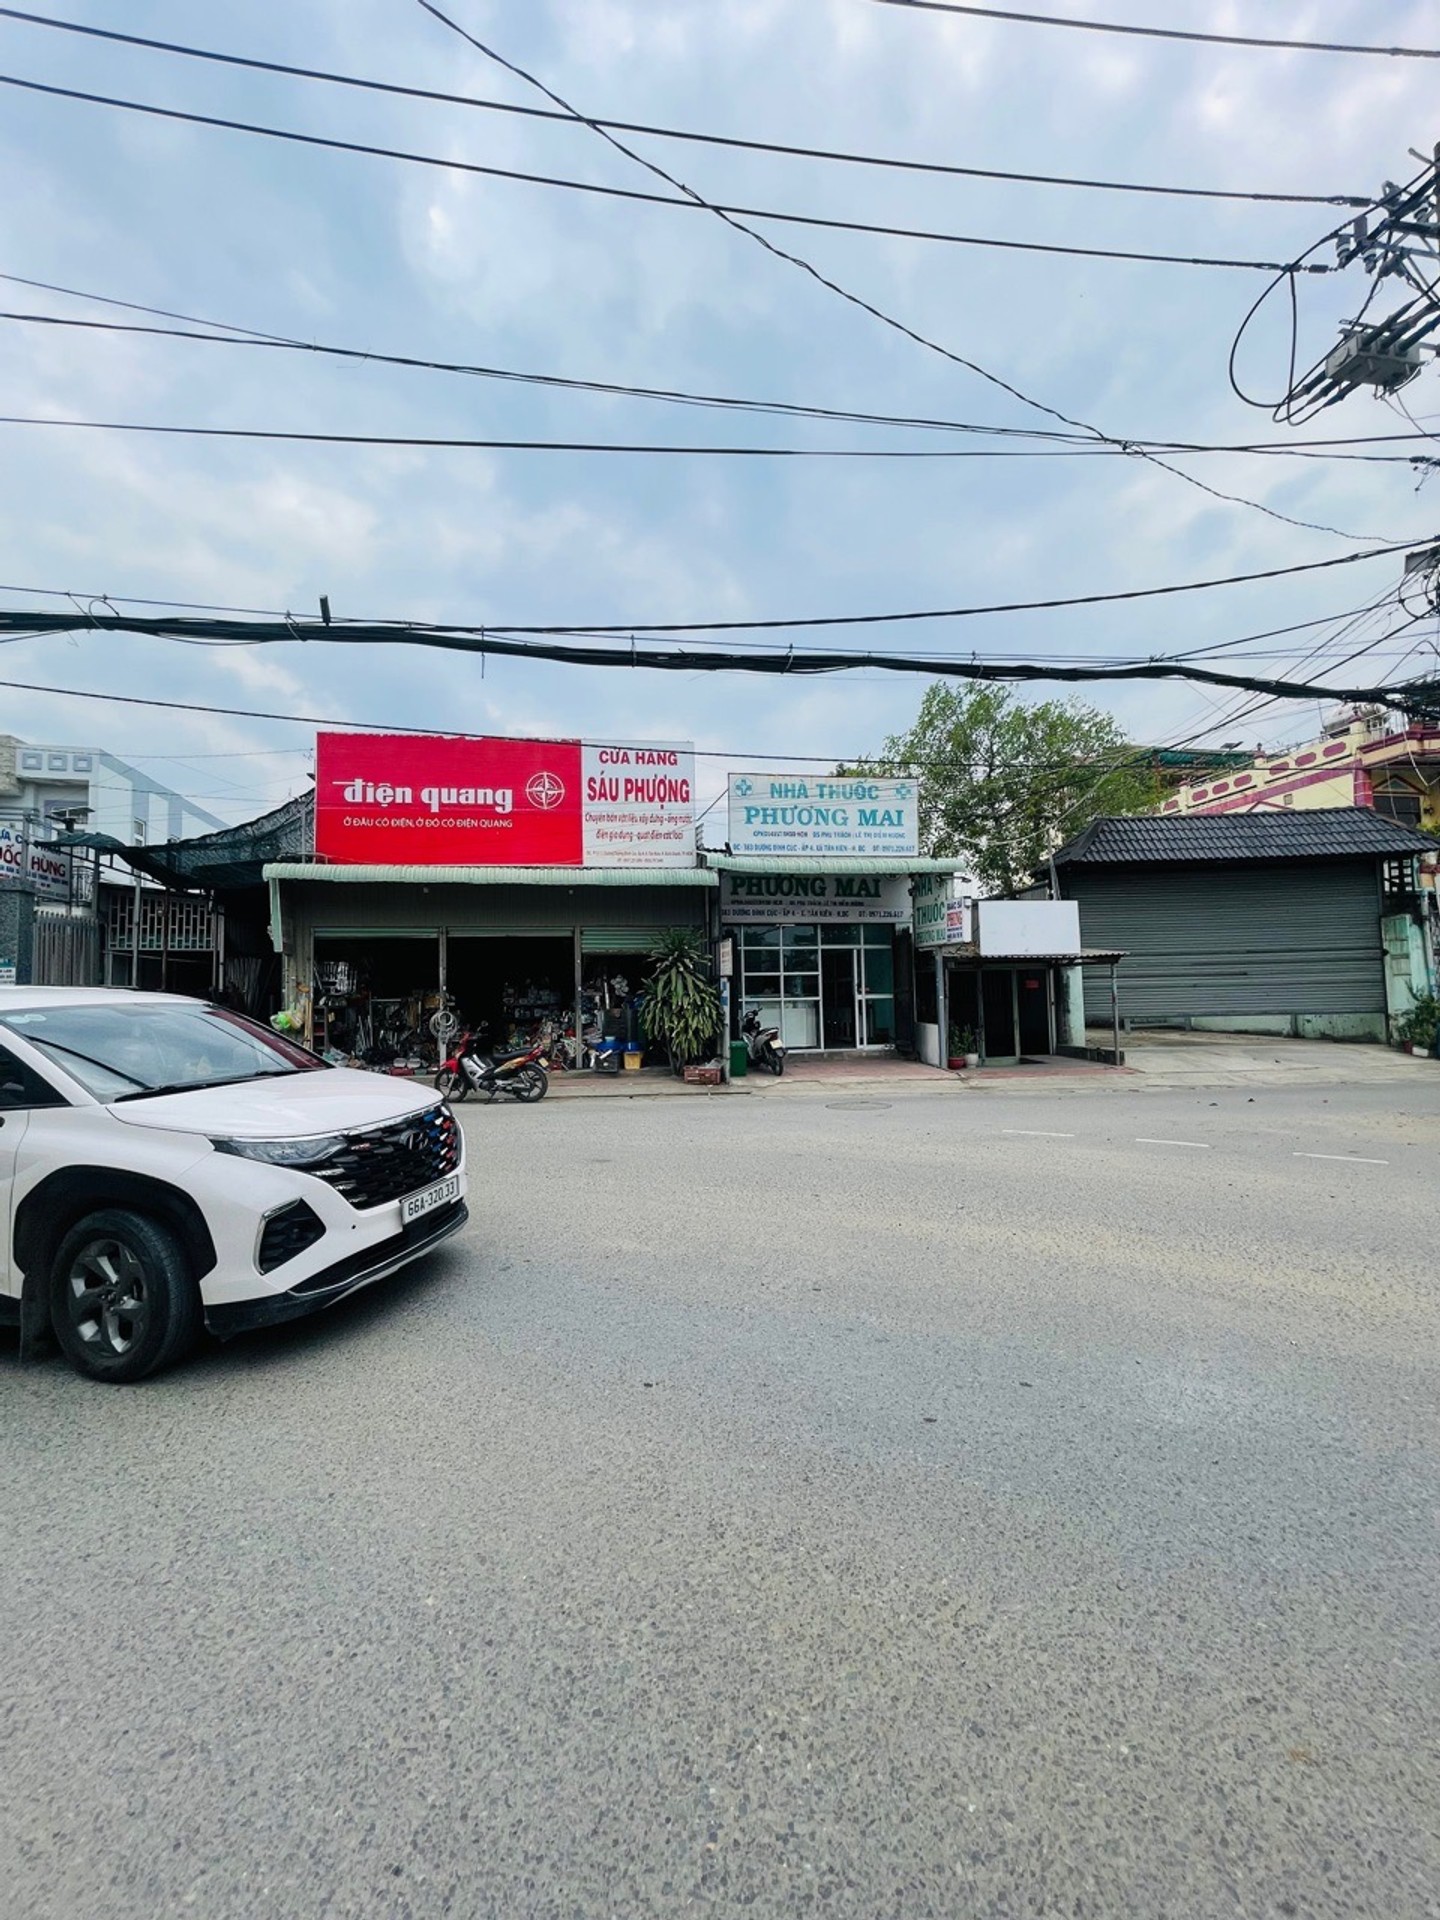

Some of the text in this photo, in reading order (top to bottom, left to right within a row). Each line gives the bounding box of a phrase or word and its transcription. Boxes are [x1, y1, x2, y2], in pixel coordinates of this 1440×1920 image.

[332, 778, 513, 814] điện quang
[587, 770, 690, 809] SÁU PHƯỢNG
[770, 778, 880, 800] NHÀ THUỐC
[353, 817, 373, 828] ĐÂU
[479, 818, 513, 829] QUANG
[743, 804, 904, 827] PHƯƠNG MAI
[31, 853, 66, 877] HÙNG
[730, 874, 882, 898] PHƯƠNG MAI
[916, 894, 945, 926] THUỐC
[408, 1181, 454, 1216] 66A-320.33
